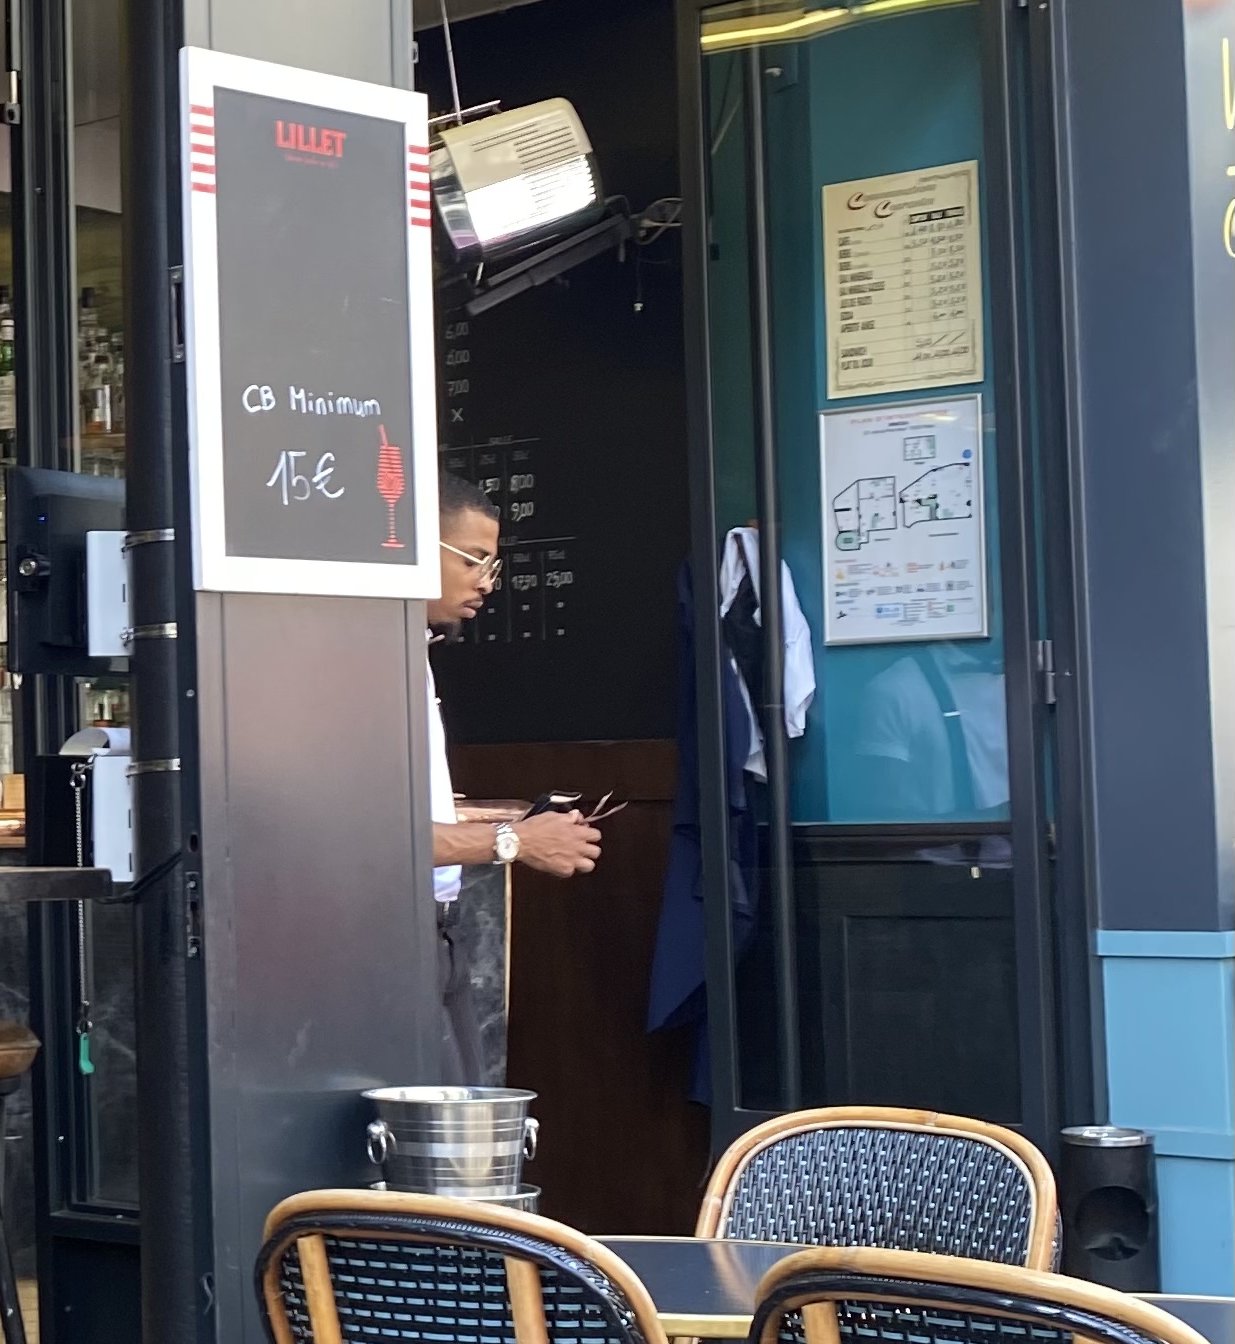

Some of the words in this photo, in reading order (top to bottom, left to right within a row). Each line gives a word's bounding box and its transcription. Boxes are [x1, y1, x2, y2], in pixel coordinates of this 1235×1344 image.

[274, 119, 347, 158] LILLET
[242, 384, 276, 413] CB
[289, 385, 381, 417] Minimum
[266, 450, 345, 506] 15€
